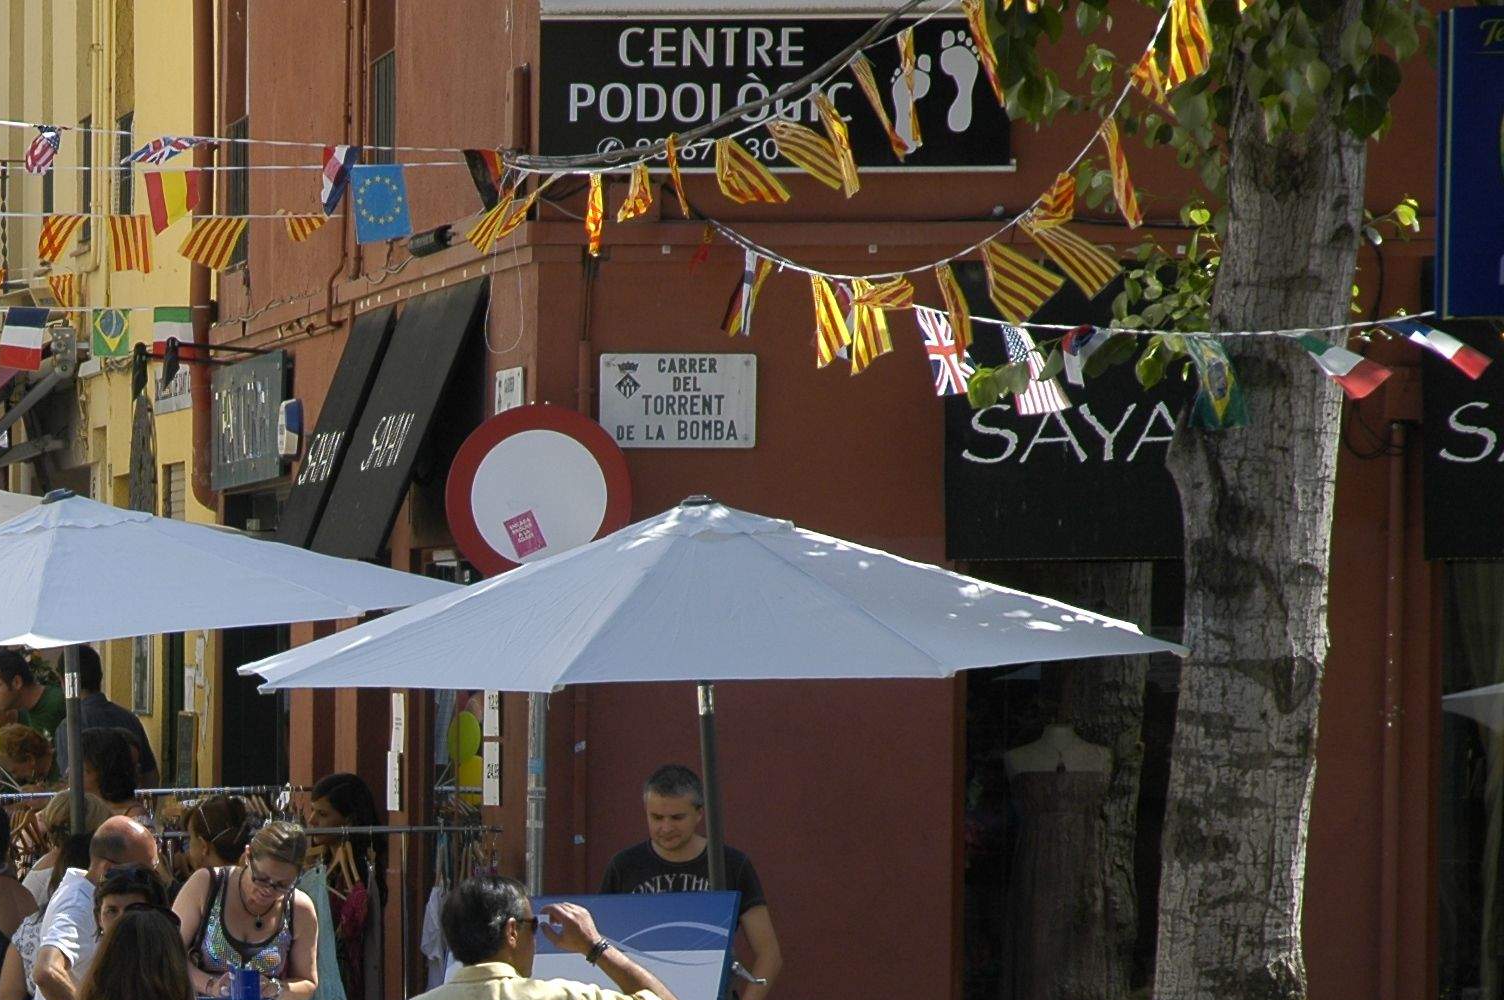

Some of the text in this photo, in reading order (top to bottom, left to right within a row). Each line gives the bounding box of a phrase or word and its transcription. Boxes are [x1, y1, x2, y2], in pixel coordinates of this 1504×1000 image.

[618, 27, 805, 67] CENTRE
[657, 358, 718, 374] CARRER
[672, 377, 702, 392] DEL
[642, 395, 725, 416] TORRENT
[616, 419, 738, 441] DE LA BOMBA
[963, 402, 1177, 463] SAYA
[1438, 402, 1504, 463] S
